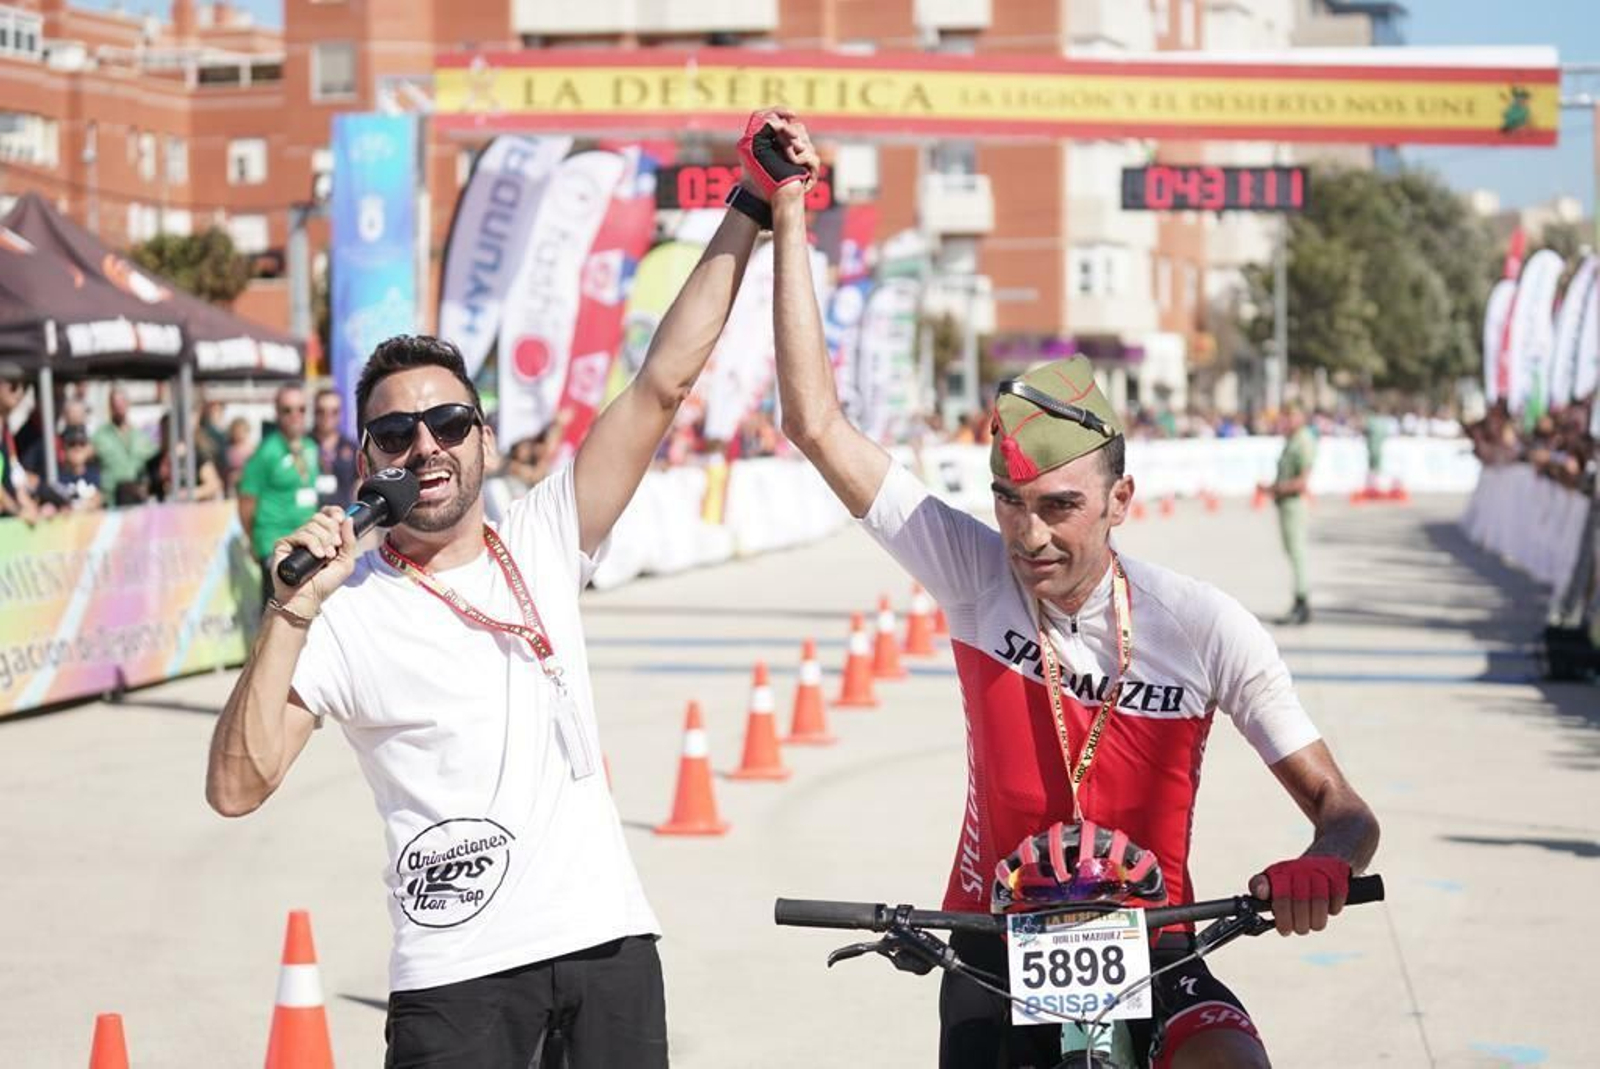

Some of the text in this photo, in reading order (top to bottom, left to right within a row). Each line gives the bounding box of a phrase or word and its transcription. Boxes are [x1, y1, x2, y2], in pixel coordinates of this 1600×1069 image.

[523, 76, 584, 106] LA
[1344, 92, 1407, 116] NOS
[1415, 94, 1477, 118] UNE
[1022, 944, 1126, 989] 5898
